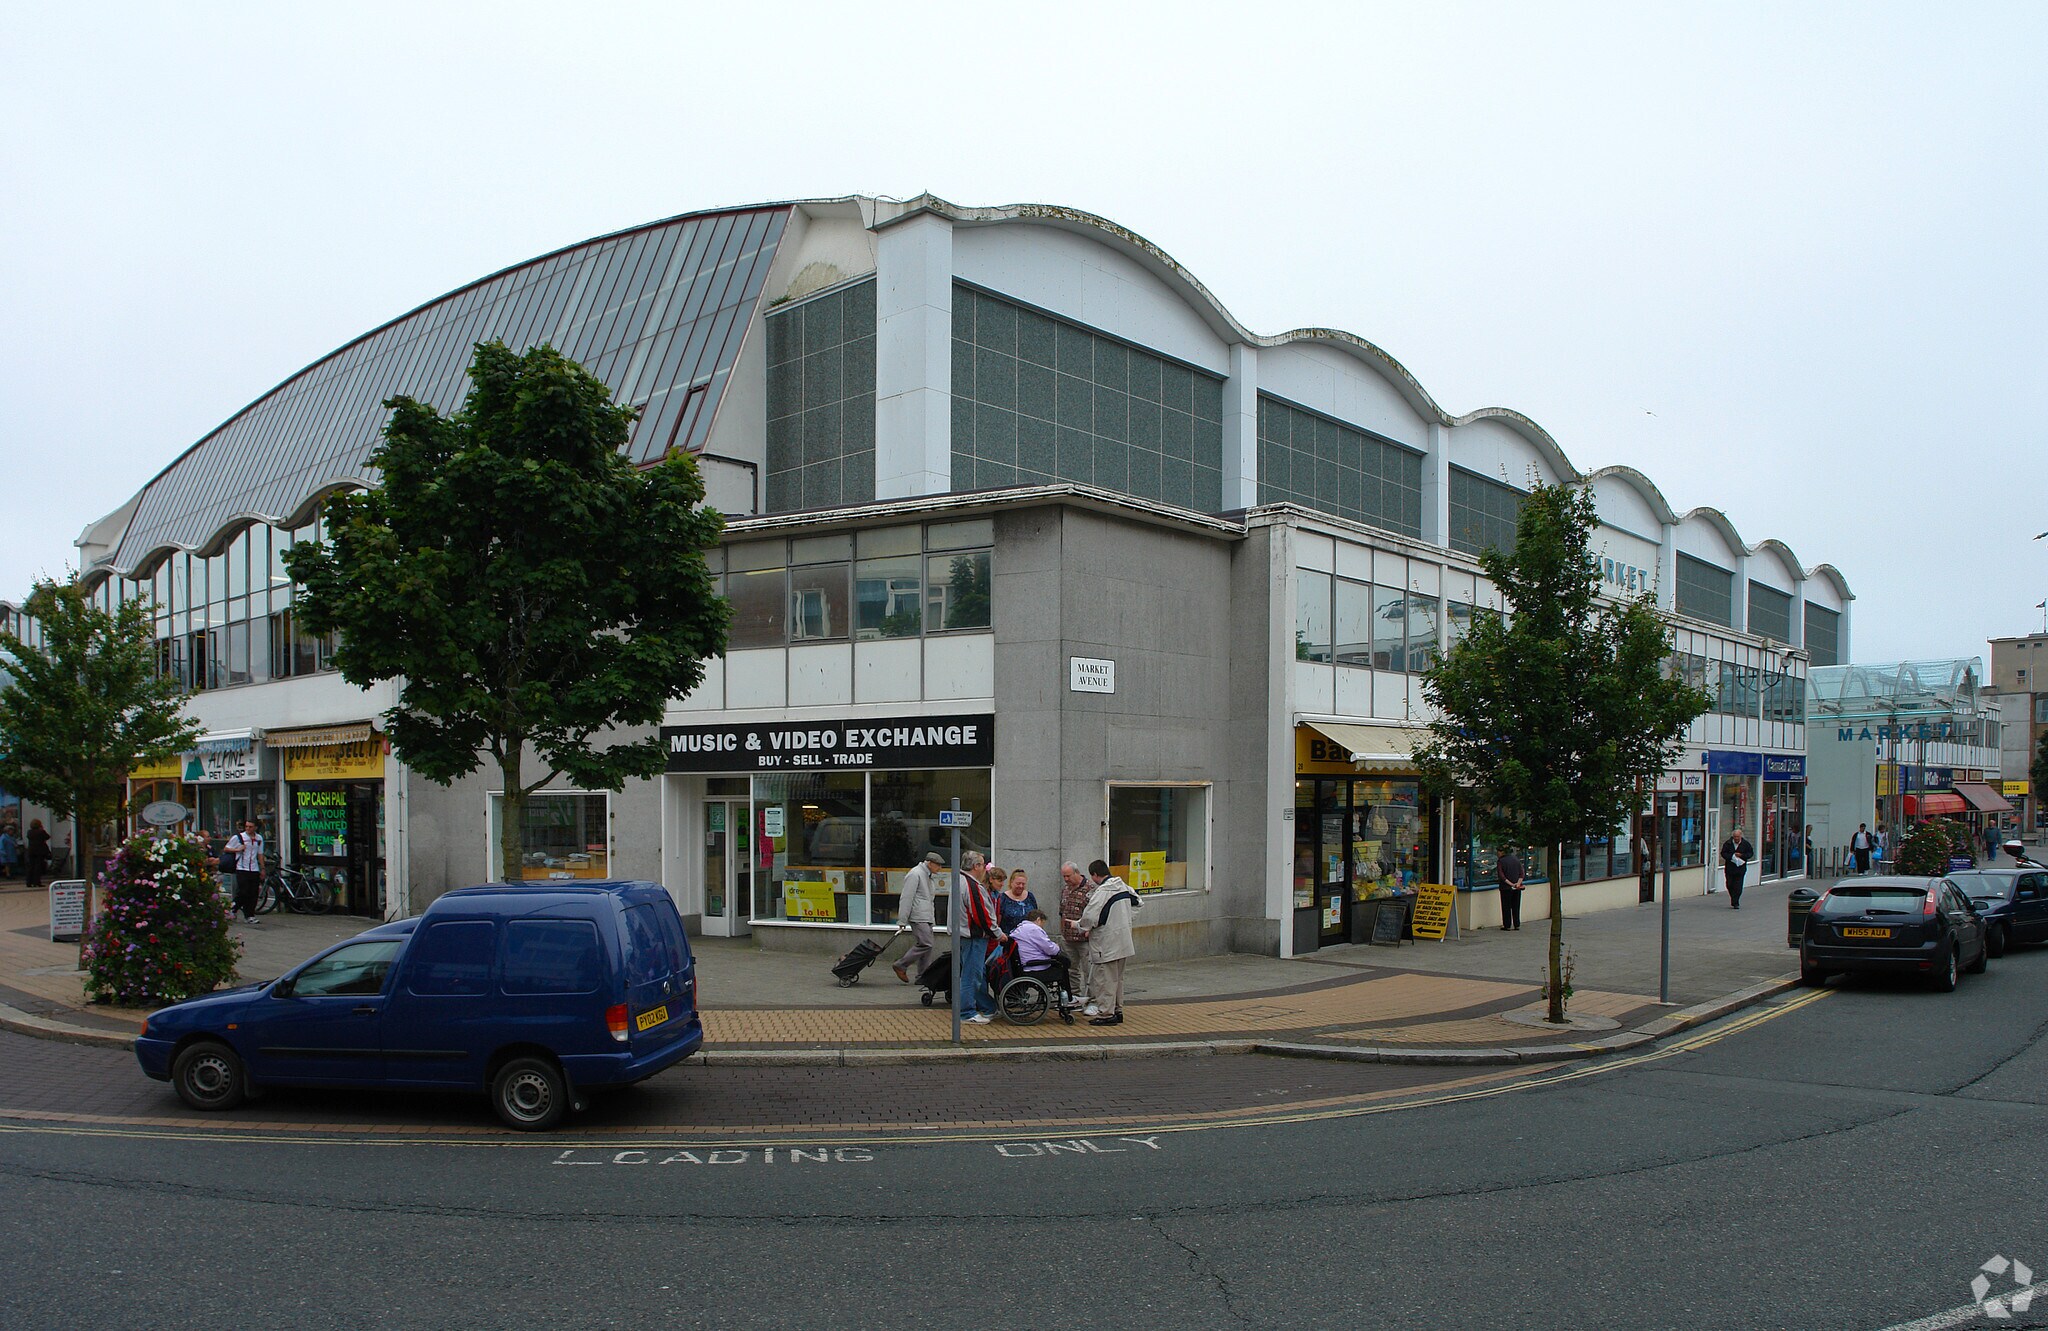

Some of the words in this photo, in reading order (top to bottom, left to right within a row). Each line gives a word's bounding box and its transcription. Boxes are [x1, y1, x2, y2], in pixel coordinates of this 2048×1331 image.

[1077, 663, 1109, 675] MARKET
[1077, 676, 1108, 687] AVENUE
[1838, 723, 1952, 742] MARKET
[670, 733, 738, 753] MUSIC
[744, 732, 762, 750] &
[769, 729, 838, 750] VIDEO
[845, 725, 977, 748] EXCHANGE
[207, 749, 246, 769] ALPINE
[758, 755, 782, 766] BUY
[792, 754, 822, 766] SELL
[832, 753, 873, 765] TRADE
[208, 770, 222, 780] PET
[225, 769, 246, 780] SHOP
[297, 791, 311, 806] TOP
[311, 791, 331, 806] CASH
[300, 809, 318, 819] FOR
[321, 809, 346, 819] YOUR
[297, 820, 348, 831] UNWANTED
[309, 835, 336, 846] ITEMS
[804, 908, 813, 916] to
[1871, 928, 1887, 936] AUA
[551, 1147, 876, 1165] LOADING
[994, 1136, 1162, 1158] ONLY
